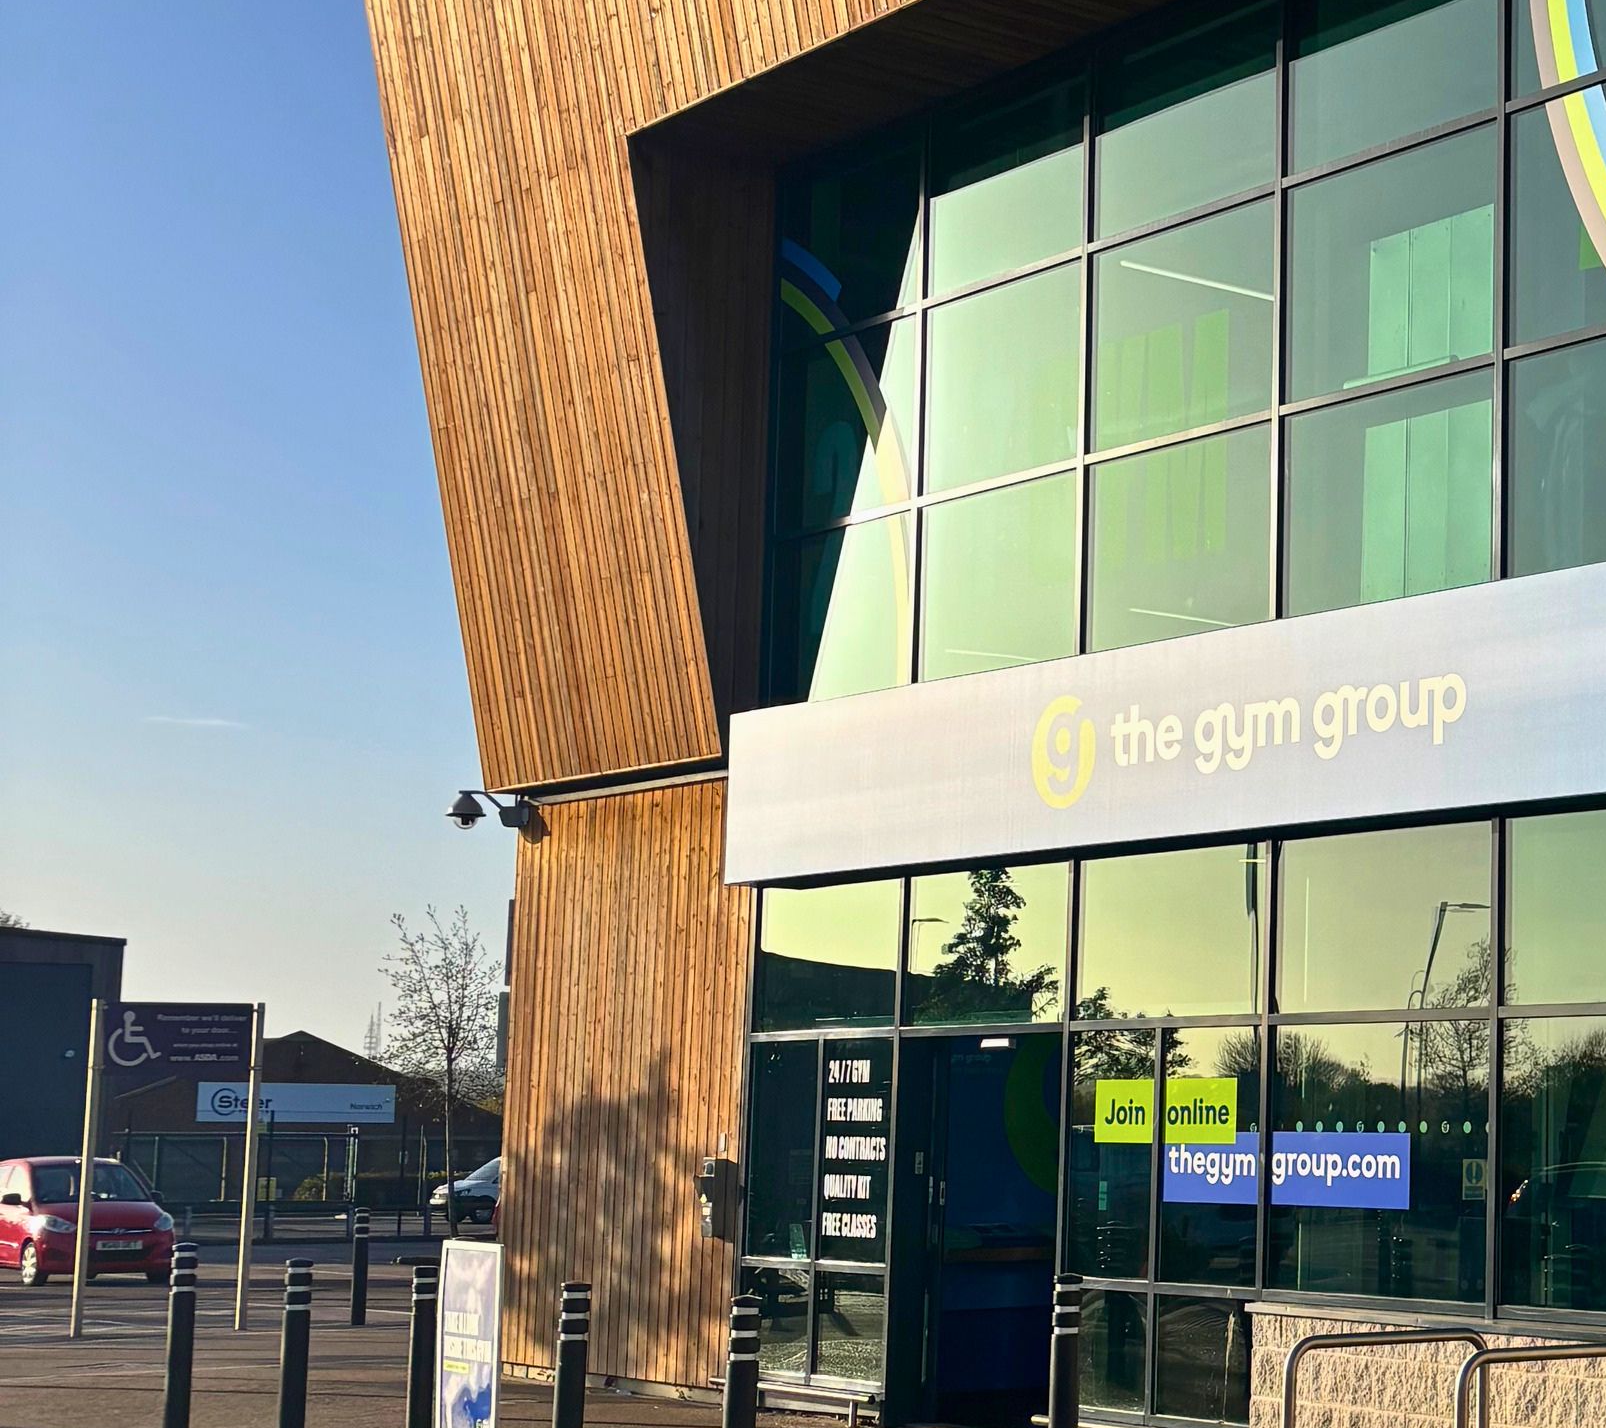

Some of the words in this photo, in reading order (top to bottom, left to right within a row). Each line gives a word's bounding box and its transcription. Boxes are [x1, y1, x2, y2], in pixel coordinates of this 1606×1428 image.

[1110, 703, 1183, 767] the
[1193, 695, 1301, 775] gym
[1312, 673, 1468, 760] group
[852, 1059, 871, 1083] GYM
[827, 1098, 846, 1121] FREE
[847, 1098, 883, 1122] PARKING
[1105, 1098, 1145, 1125] Join
[1167, 1097, 1229, 1125] online
[825, 1136, 838, 1160] NO
[838, 1136, 886, 1161] CONTRACTS
[823, 1174, 857, 1200] QUALITY
[857, 1175, 872, 1200] KIT
[822, 1212, 841, 1237] FREE
[841, 1213, 877, 1239] CLASSES
